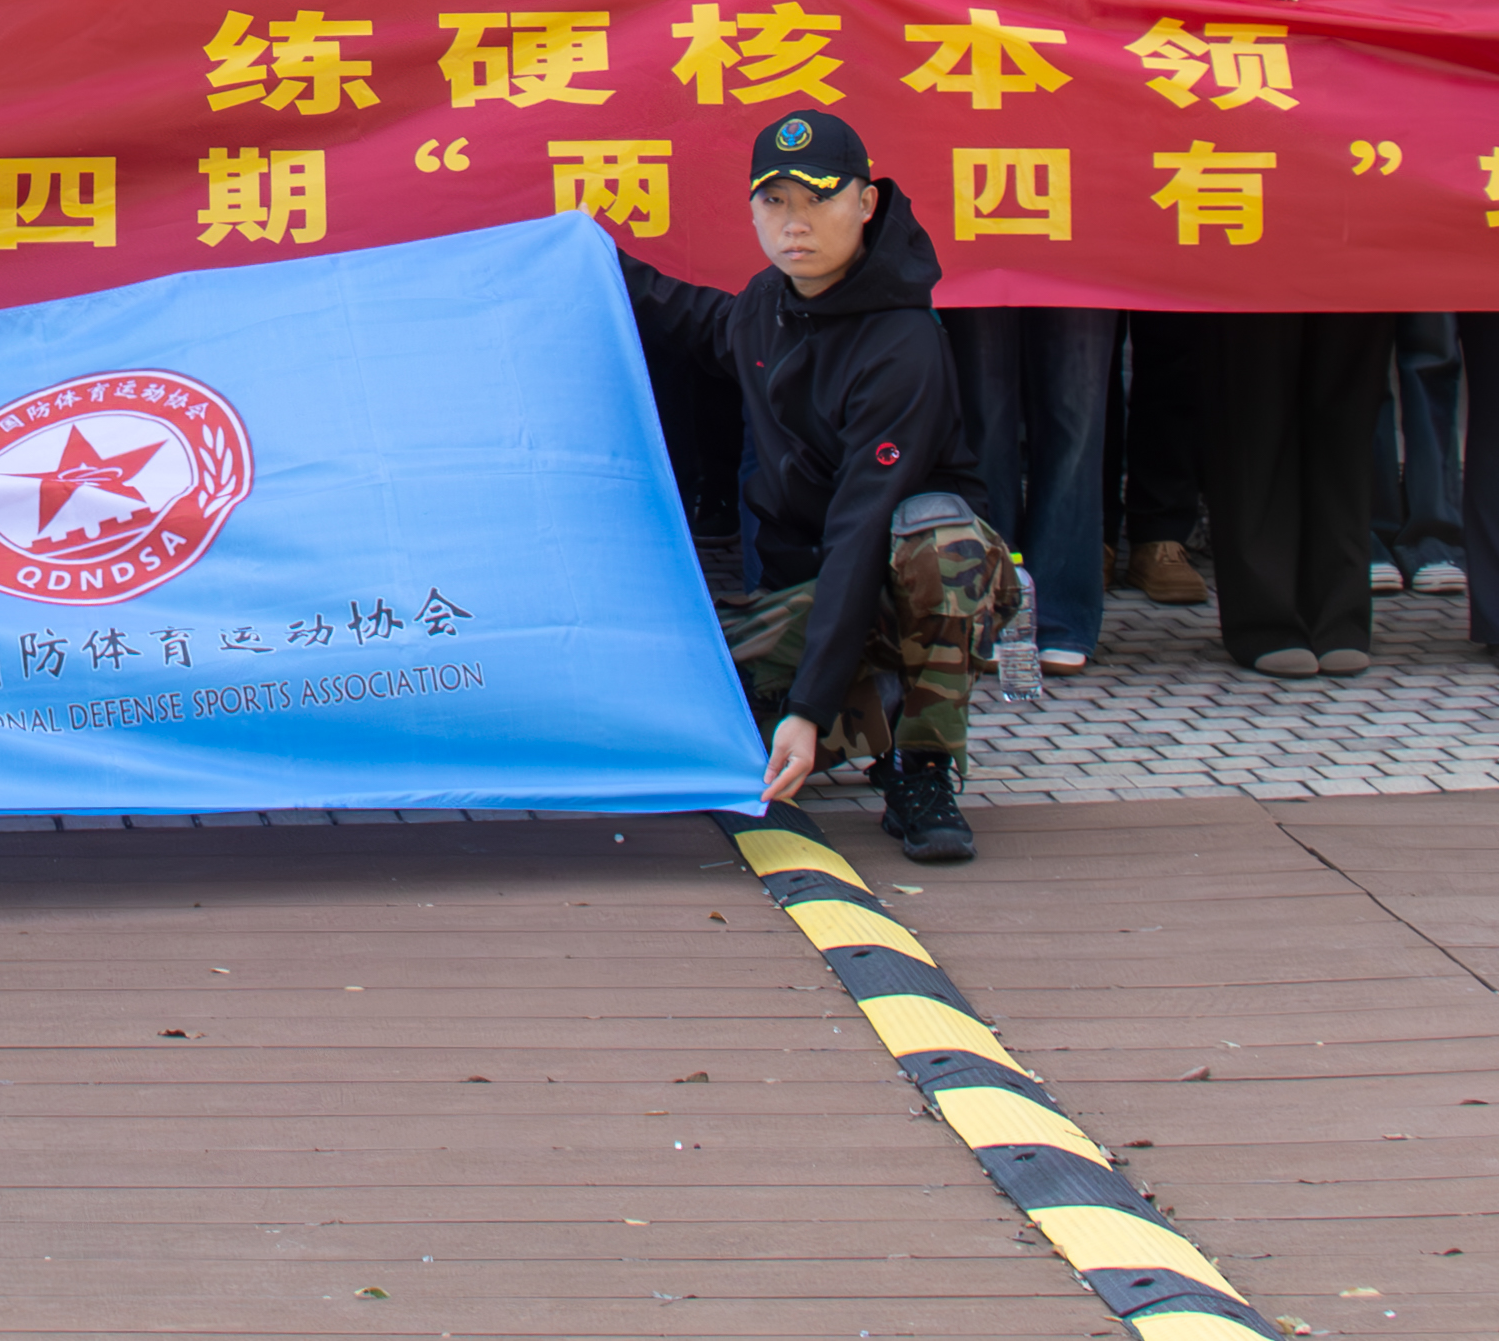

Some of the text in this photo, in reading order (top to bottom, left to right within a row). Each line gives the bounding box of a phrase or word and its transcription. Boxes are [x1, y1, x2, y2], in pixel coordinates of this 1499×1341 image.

[203, 1, 1298, 115] 练硬核本领
[16, 529, 187, 591] QDNDSA
[68, 692, 184, 731] DEFENSE
[192, 680, 291, 718] SPORTS
[301, 661, 484, 706] ASSOCIATION
